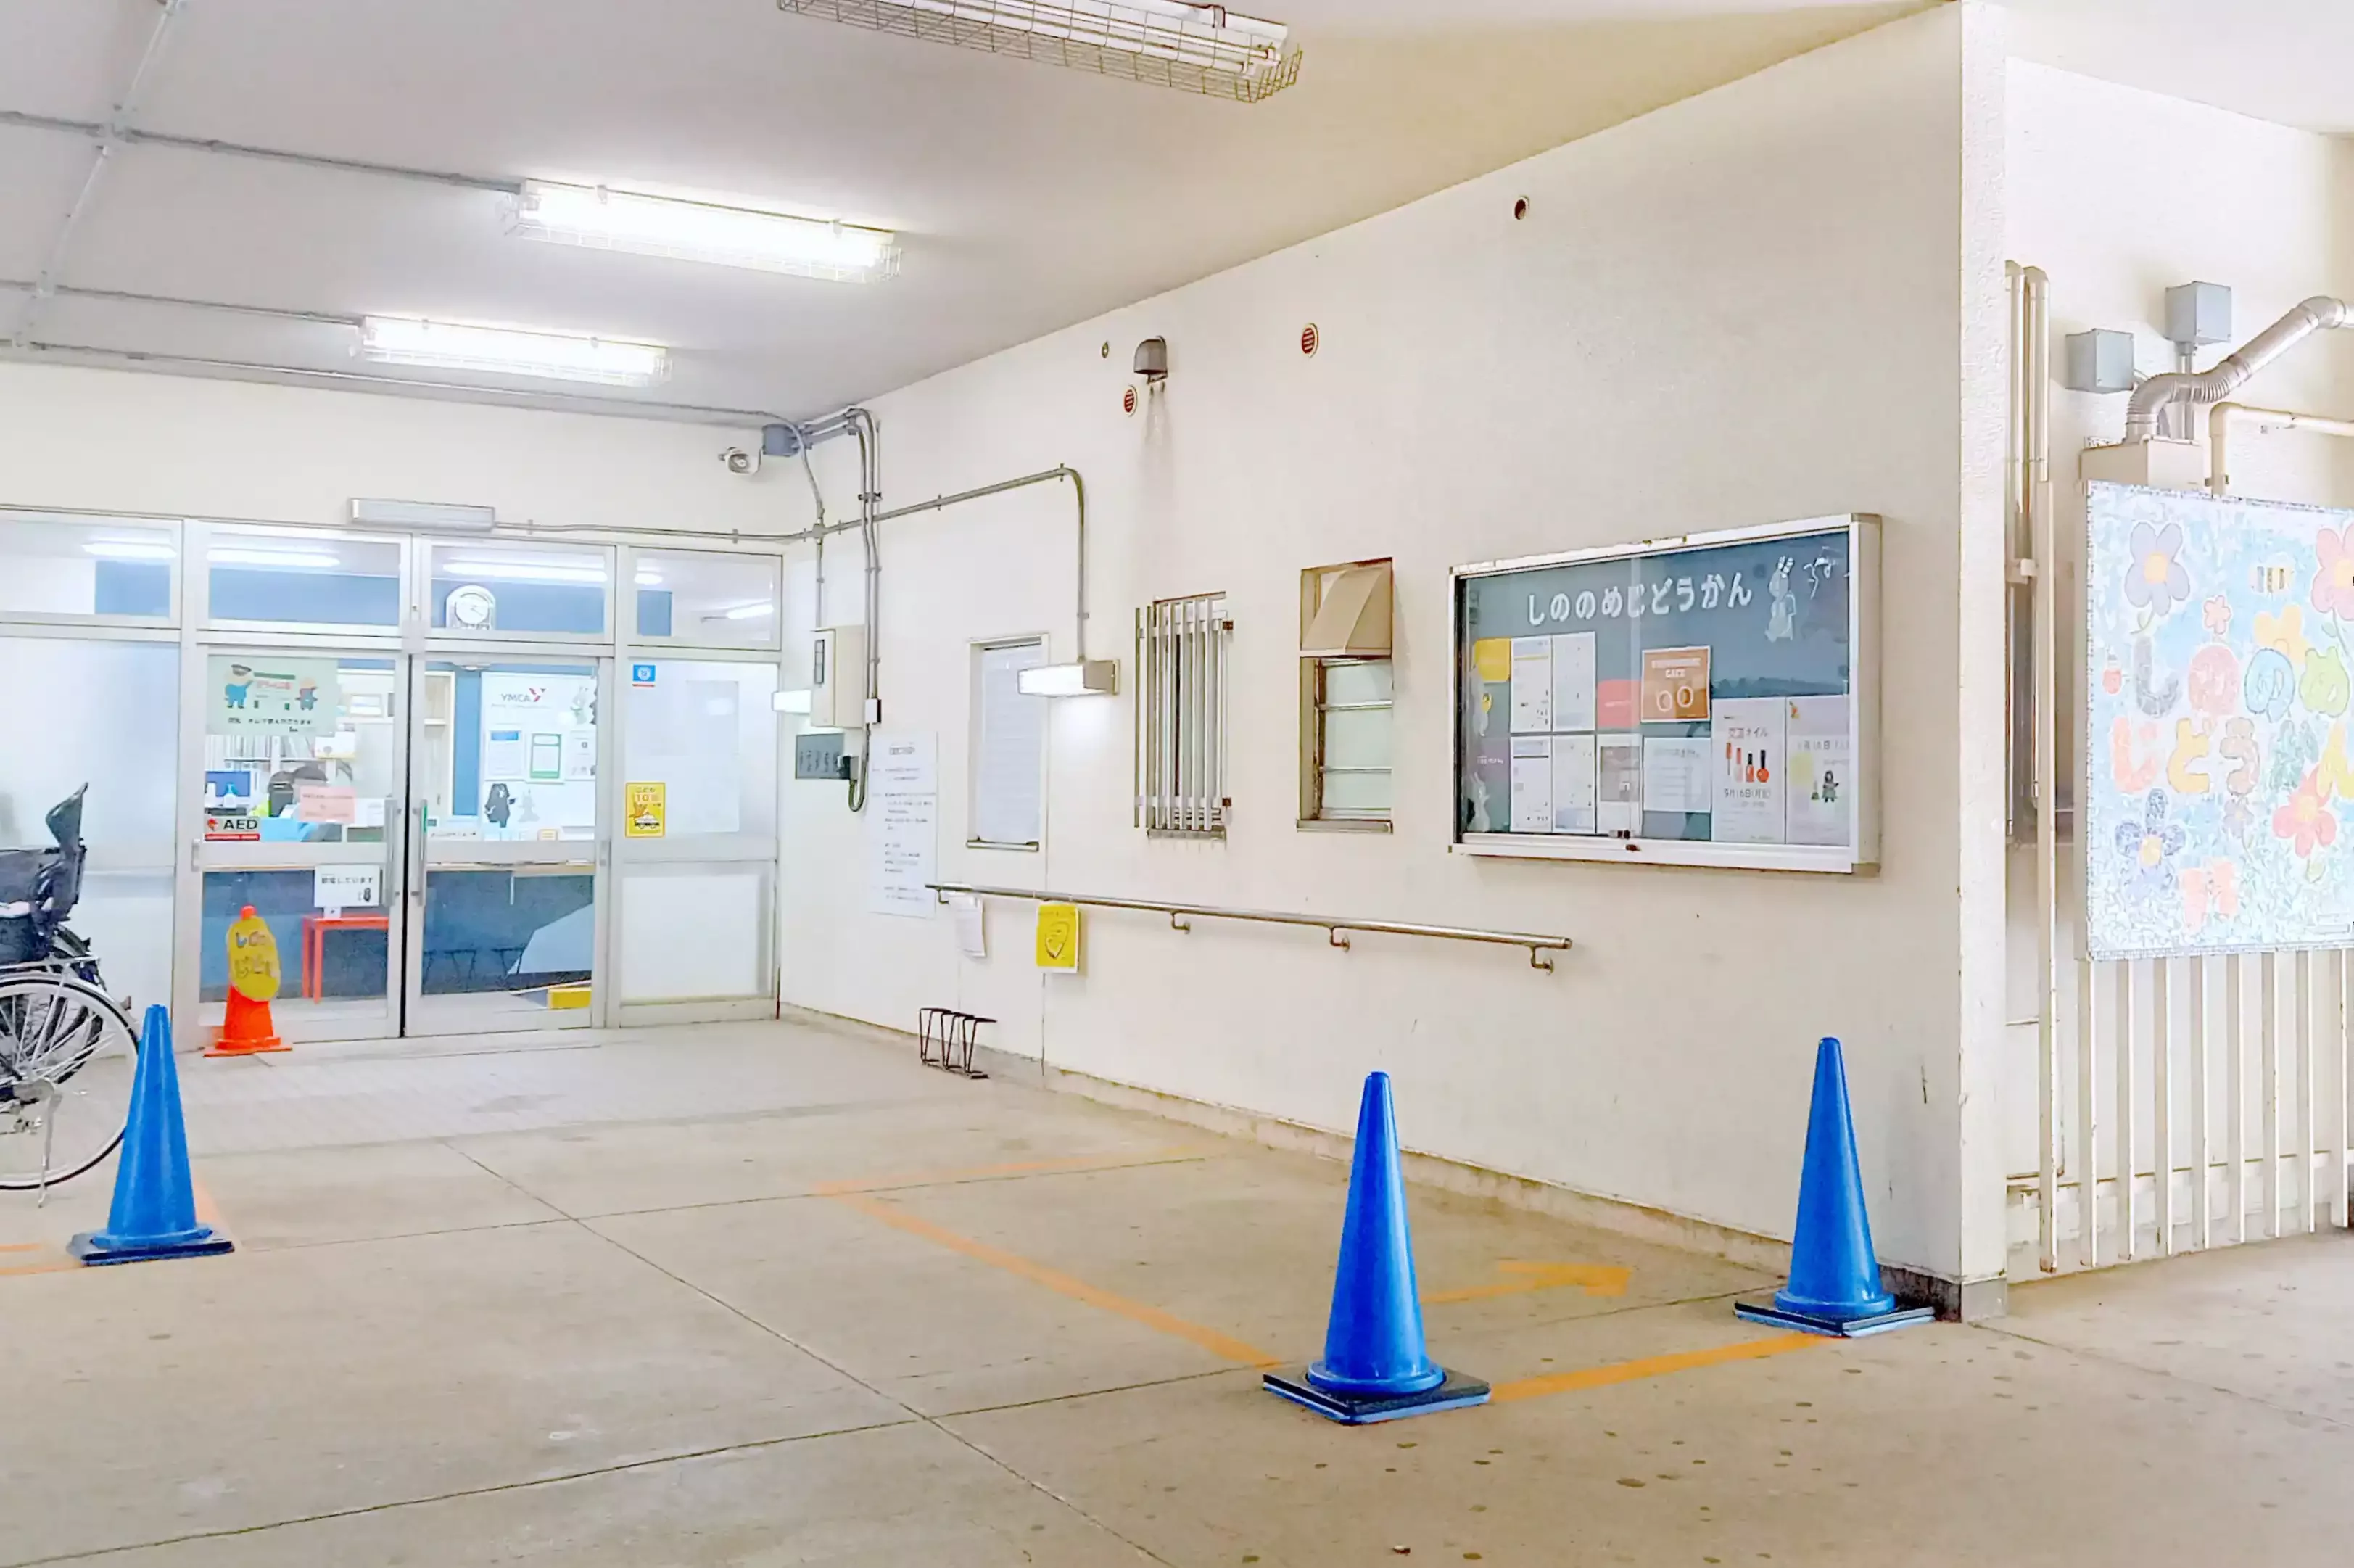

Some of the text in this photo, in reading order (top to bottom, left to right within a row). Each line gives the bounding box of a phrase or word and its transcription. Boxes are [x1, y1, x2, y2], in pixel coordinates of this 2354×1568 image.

[1527, 572, 1752, 627] しののめじどうかん
[2130, 637, 2351, 723] しののめ
[500, 693, 531, 703] YMCA
[223, 818, 258, 830] AED
